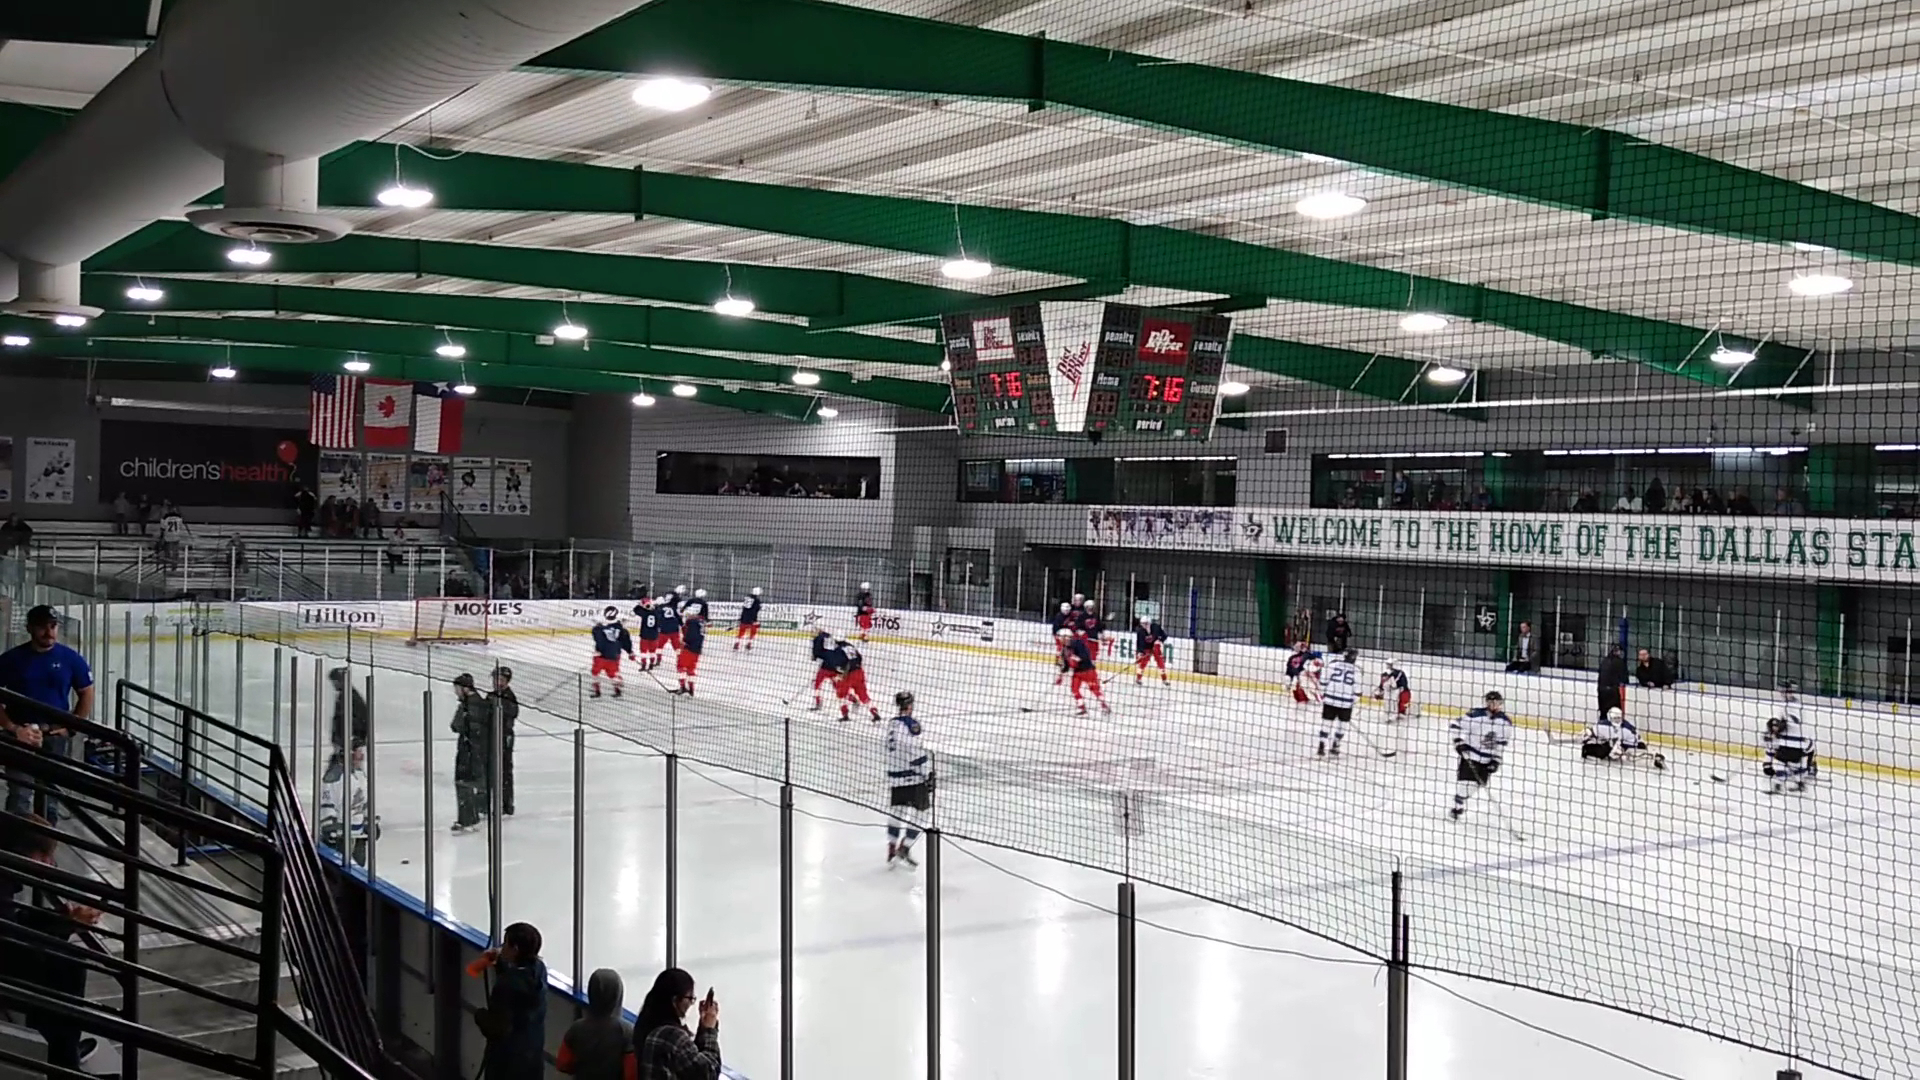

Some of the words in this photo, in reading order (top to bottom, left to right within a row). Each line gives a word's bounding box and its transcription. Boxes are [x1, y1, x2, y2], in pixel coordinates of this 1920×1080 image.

[1144, 374, 1185, 402] 7:16
[1136, 418, 1163, 431] period
[167, 522, 178, 533] 21
[1274, 516, 1382, 549] WELCOME
[1393, 519, 1421, 549] TO
[1433, 521, 1480, 552] THE
[1490, 520, 1564, 556] HOME
[1577, 522, 1609, 557] OF
[1624, 525, 1682, 562] THE
[1699, 526, 1832, 566] DALLAS
[305, 607, 377, 625] Hilton
[454, 603, 523, 616] MOXIE'S
[646, 615, 656, 628] 8
[1329, 668, 1356, 686] 26
